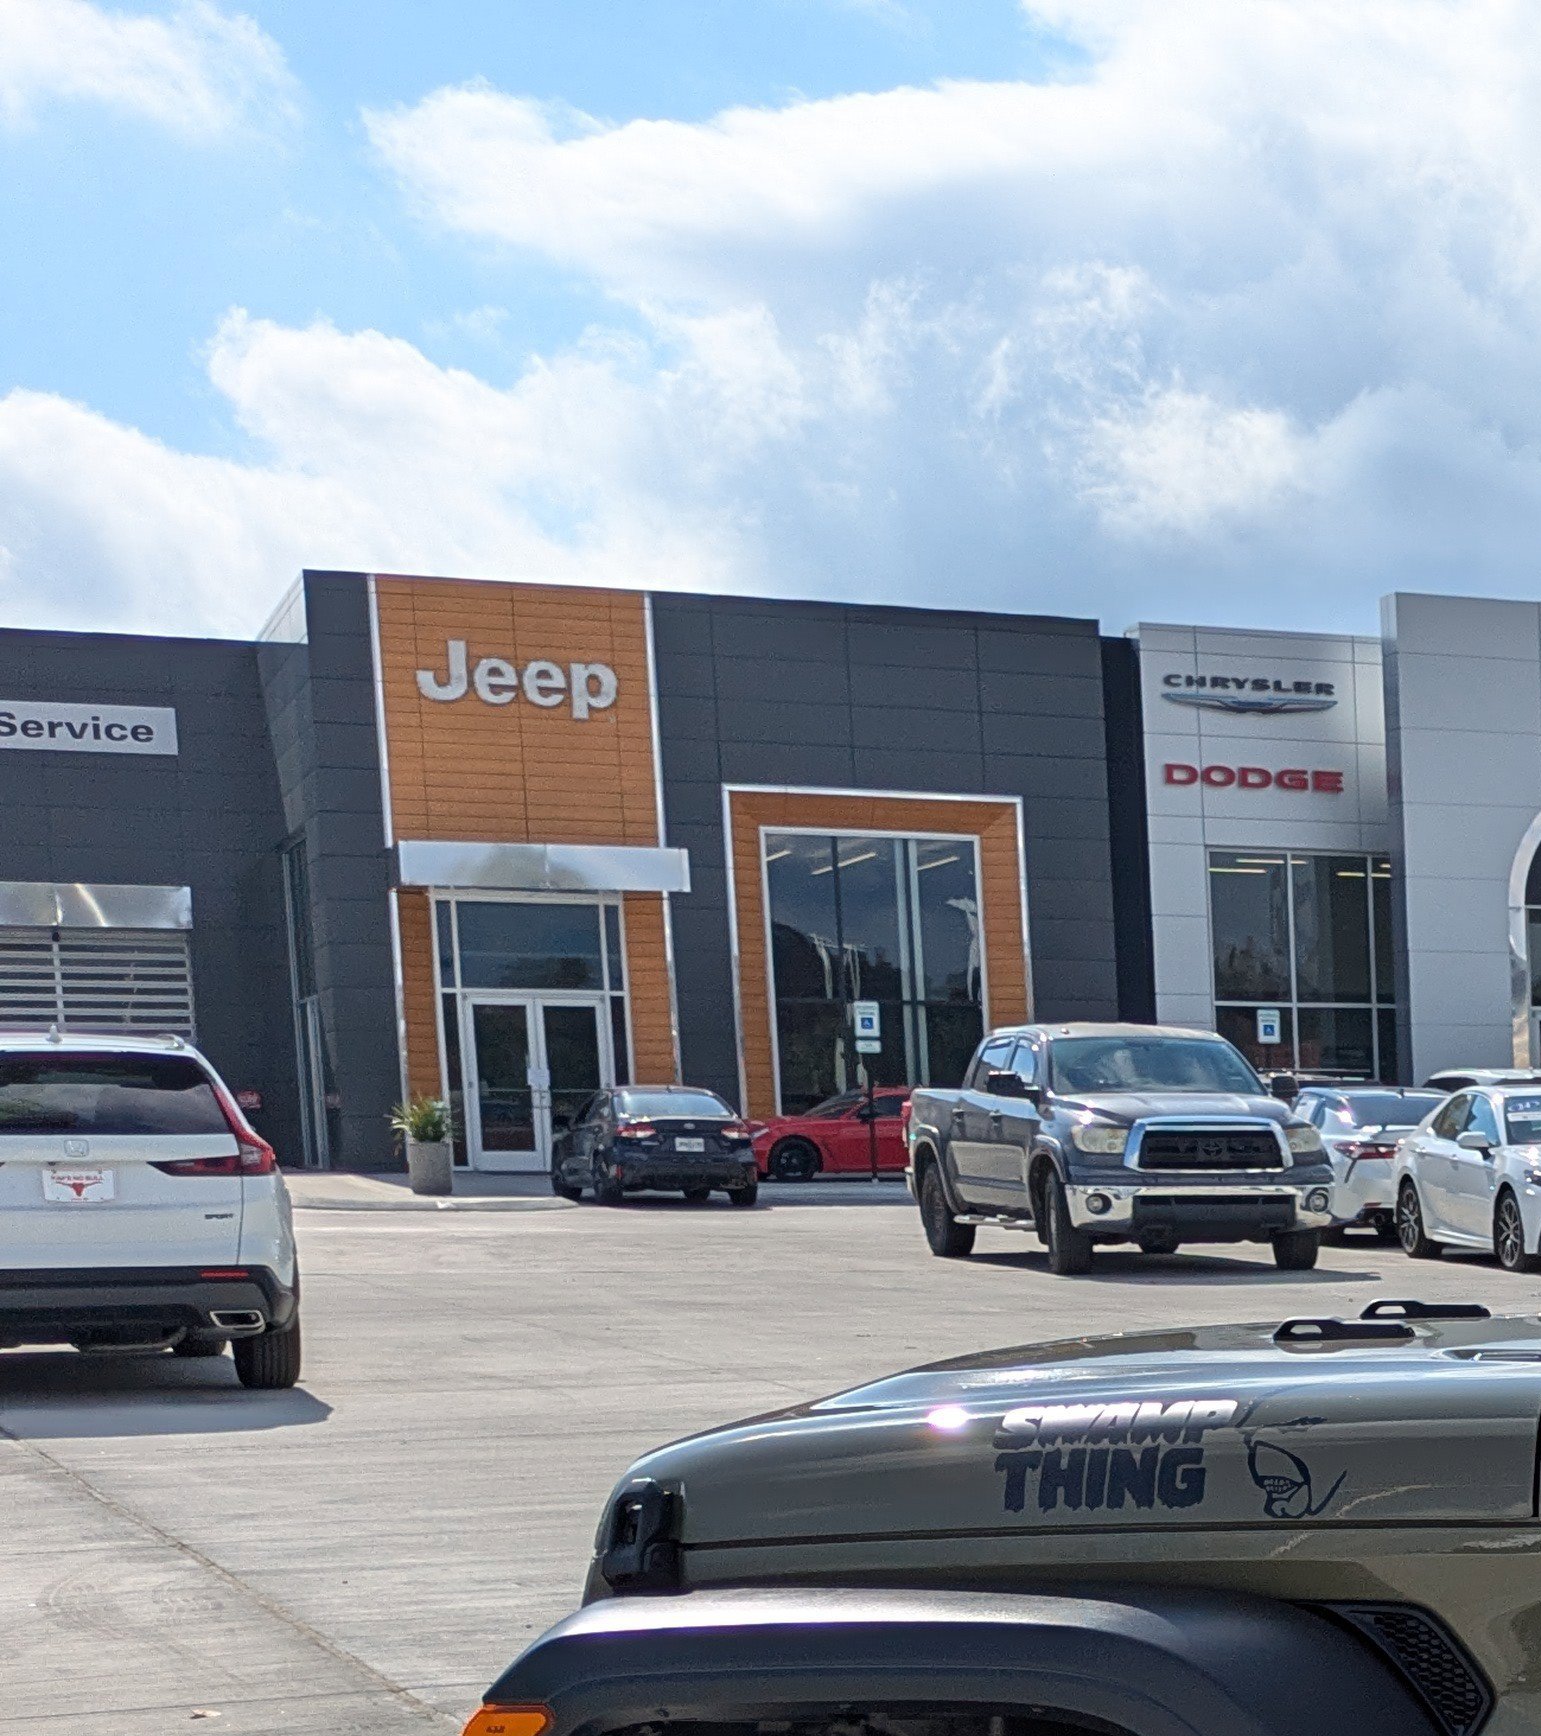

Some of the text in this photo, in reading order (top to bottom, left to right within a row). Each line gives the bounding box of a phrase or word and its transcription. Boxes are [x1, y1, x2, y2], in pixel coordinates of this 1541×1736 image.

[415, 638, 618, 720] Jeep
[1162, 674, 1335, 696] CHRYSLER
[0, 711, 154, 743] Service
[1163, 763, 1345, 793] DODGE
[994, 1400, 1238, 1450] SWAMP
[995, 1445, 1206, 1513] THING
